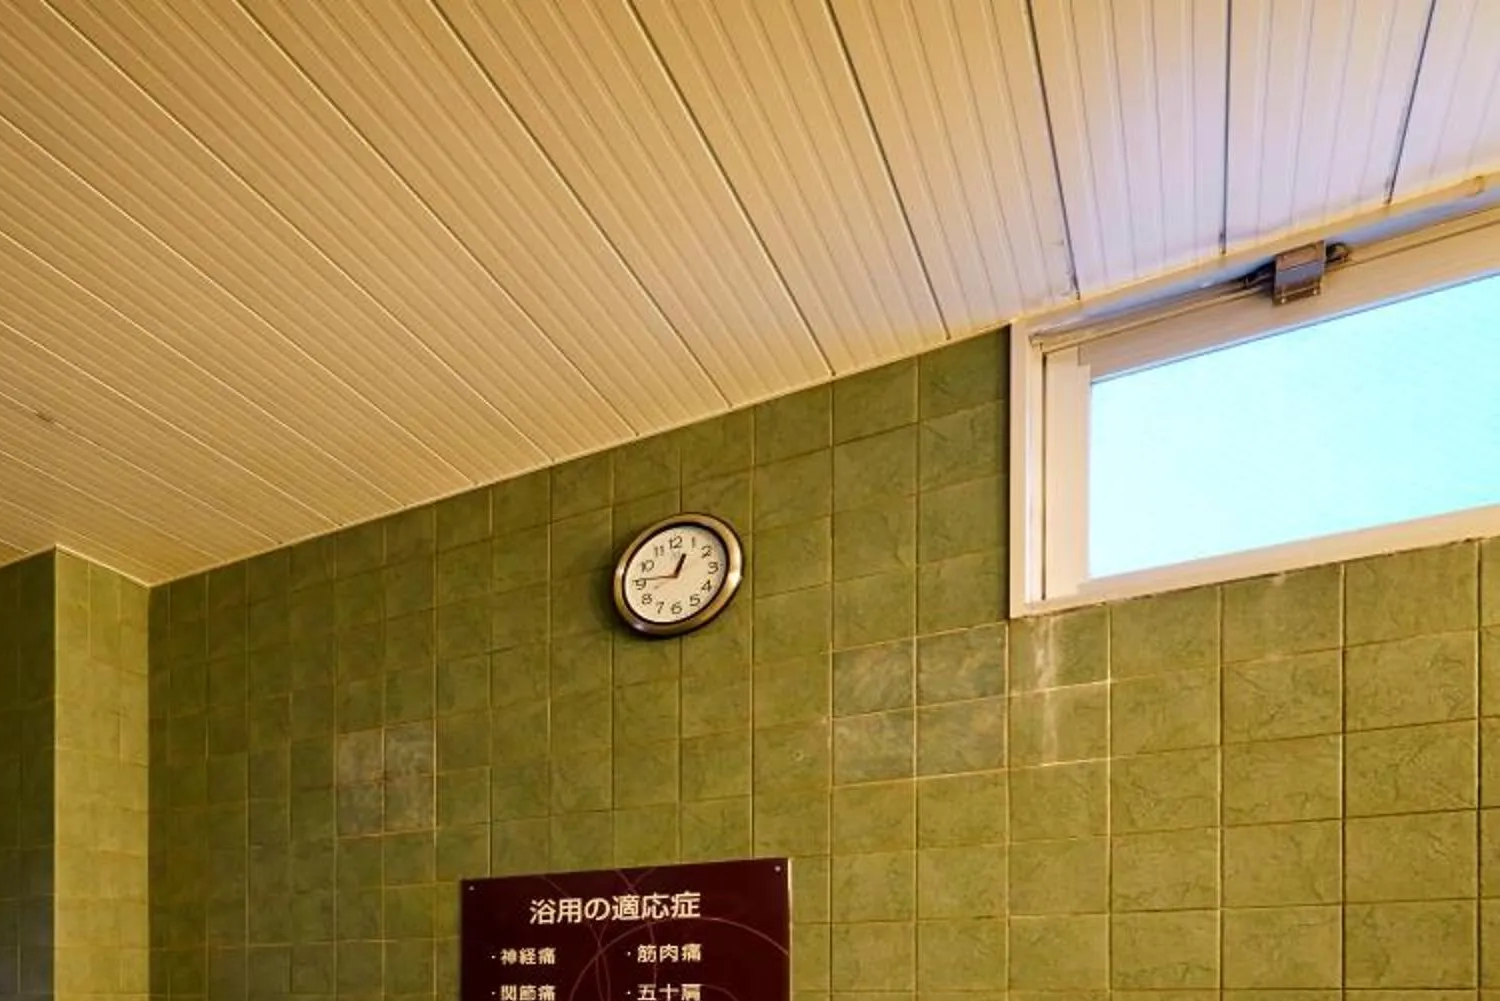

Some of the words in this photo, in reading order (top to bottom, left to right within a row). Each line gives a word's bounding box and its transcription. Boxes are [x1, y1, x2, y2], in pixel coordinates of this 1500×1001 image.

[669, 535, 683, 549] 12
[654, 545, 665, 557] 11
[701, 545, 712, 558] 2
[641, 559, 655, 573] 10
[708, 561, 719, 574] 3
[701, 579, 712, 592] 4
[641, 593, 653, 605] 8
[689, 593, 701, 606] 5
[656, 601, 665, 614] 7
[671, 602, 683, 614] 6
[529, 891, 702, 925] 浴用の適応症
[500, 947, 556, 966] 神経痛
[637, 943, 702, 964] 筋肉痛
